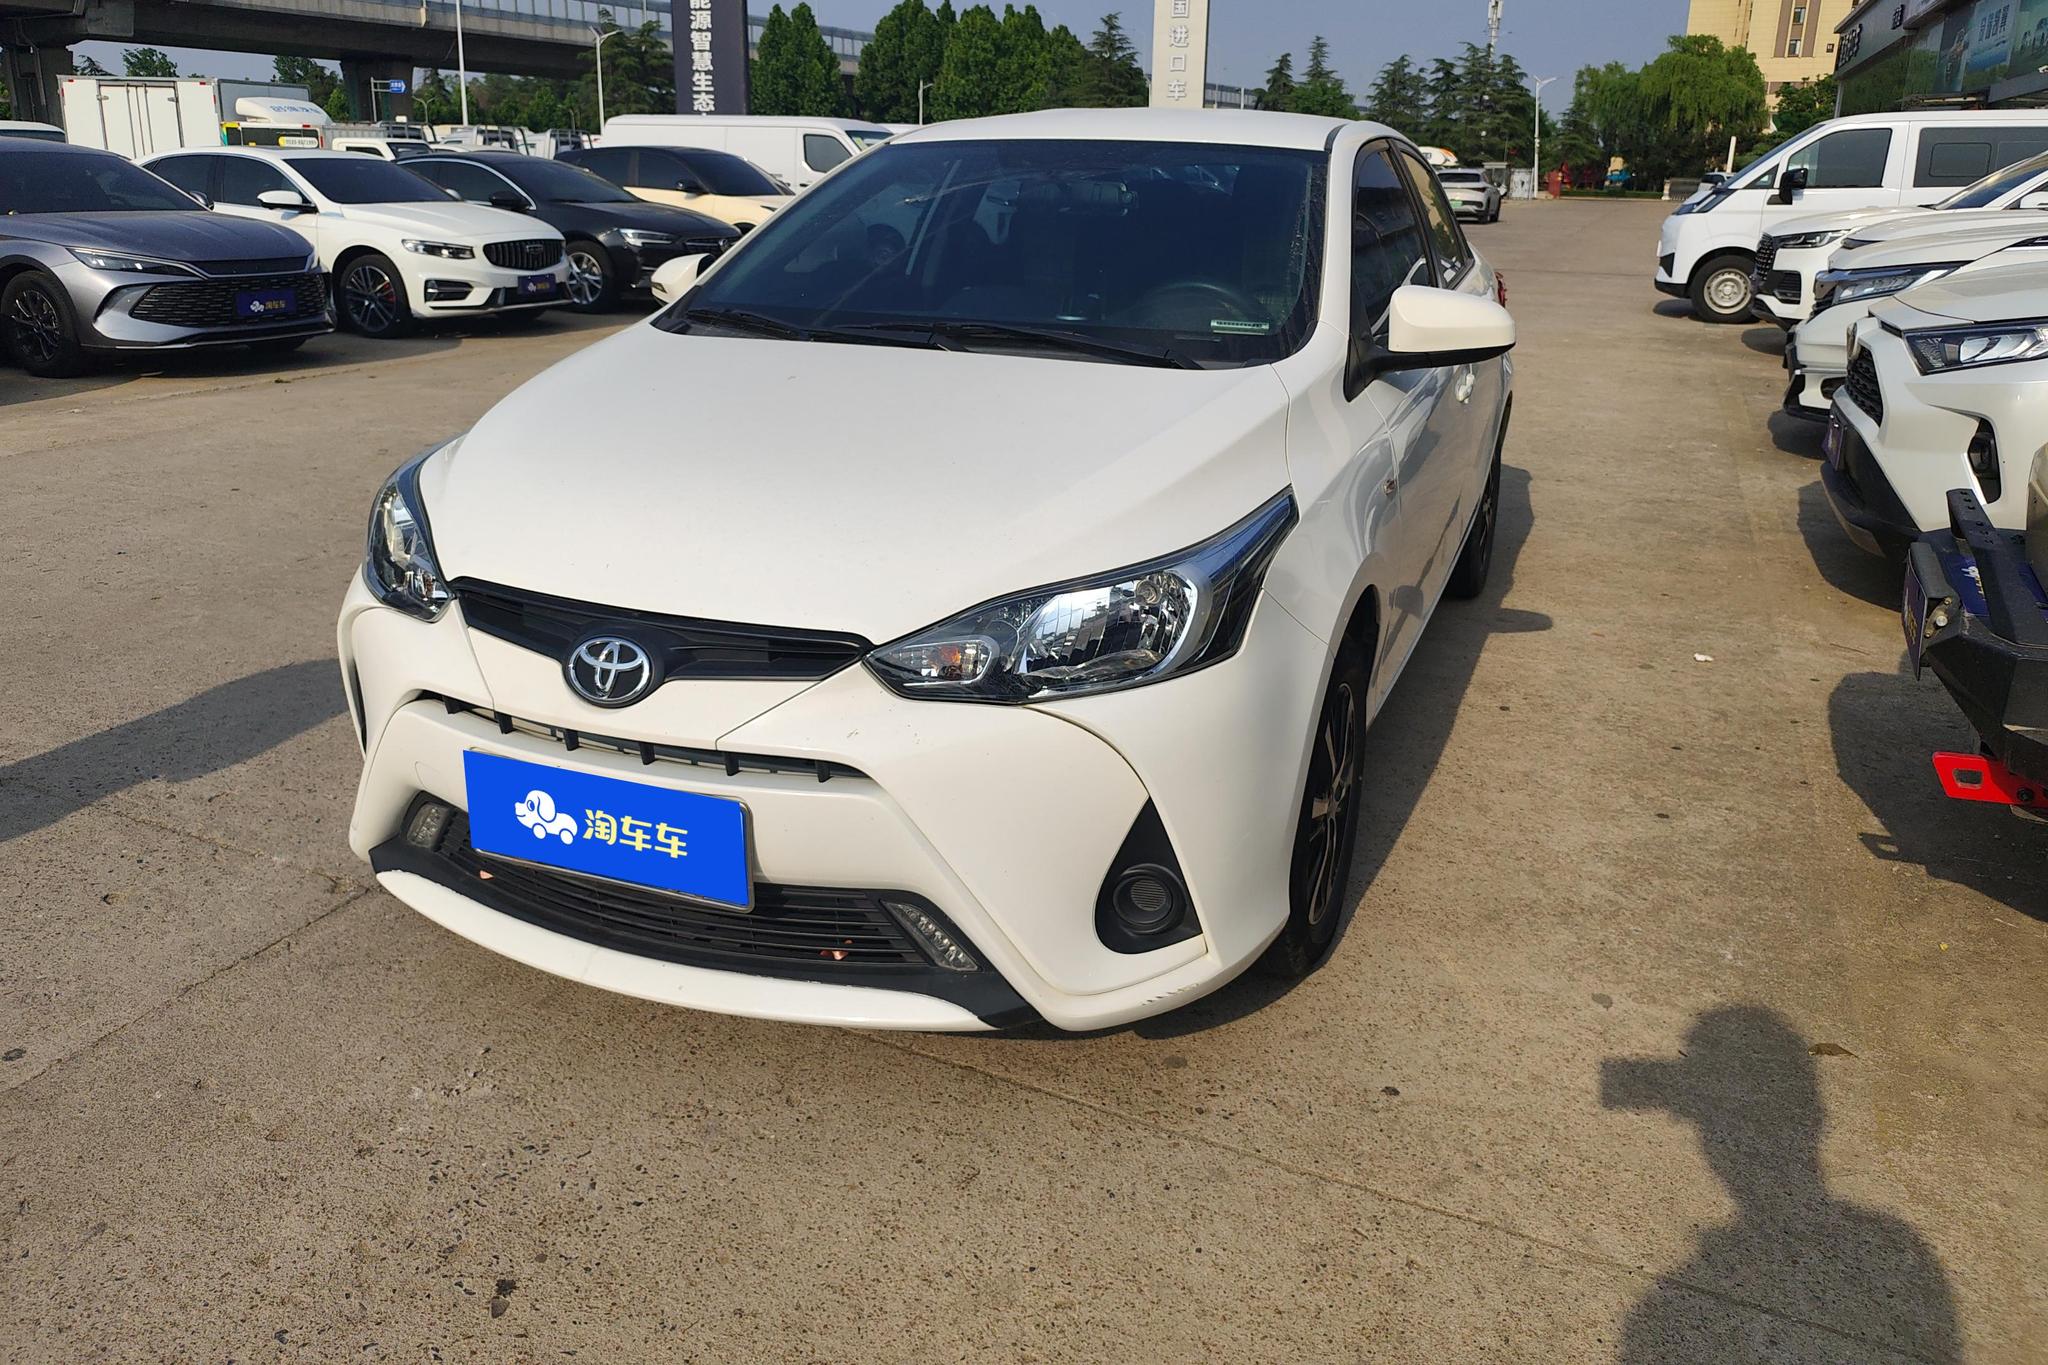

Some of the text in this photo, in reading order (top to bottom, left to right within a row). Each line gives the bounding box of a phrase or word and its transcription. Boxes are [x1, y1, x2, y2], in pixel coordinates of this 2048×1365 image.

[690, 0, 715, 115] 源智慧生态
[1167, 0, 1190, 101] 国进口车
